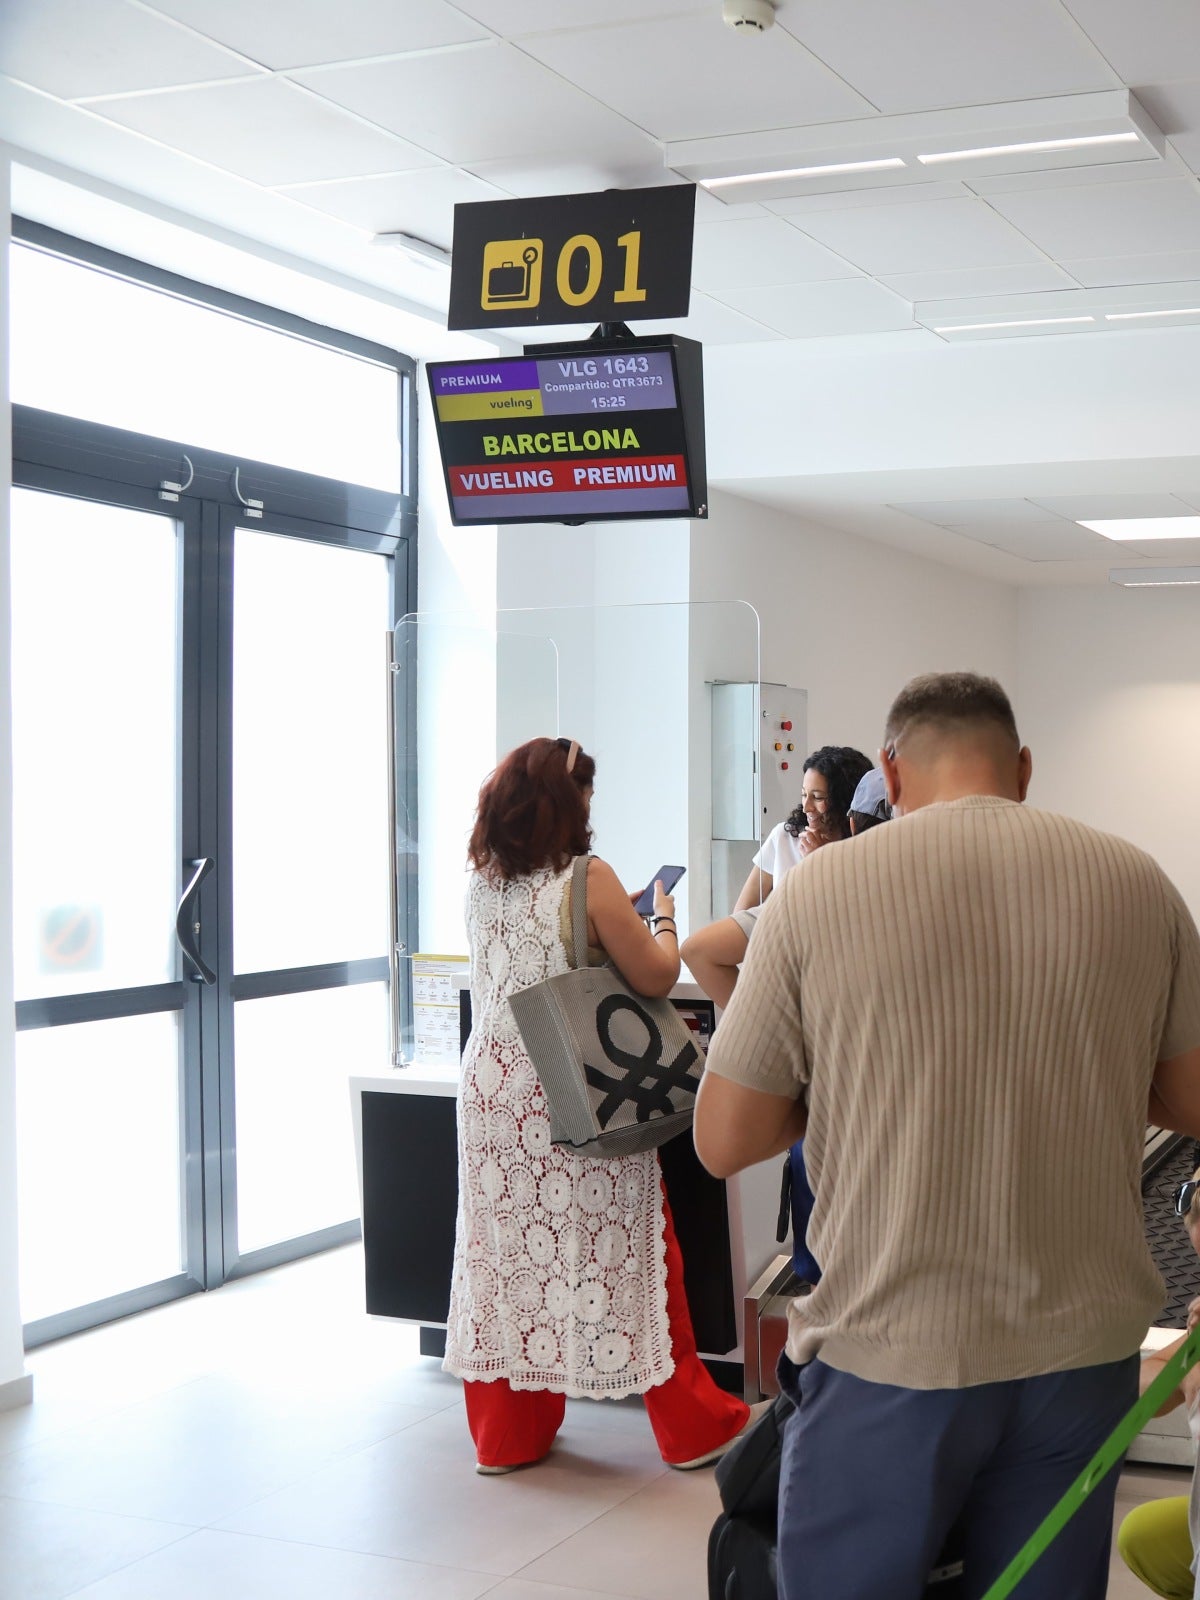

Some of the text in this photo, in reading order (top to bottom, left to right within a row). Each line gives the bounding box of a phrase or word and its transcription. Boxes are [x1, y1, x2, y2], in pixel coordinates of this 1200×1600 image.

[556, 231, 647, 306] 01
[558, 356, 649, 378] VLG 1643
[440, 373, 503, 388] PREMIUM
[544, 376, 663, 393] Compartido: QTR3673
[489, 397, 533, 410] vueling
[591, 396, 626, 409] 15:25
[482, 428, 641, 456] BARCELONA
[459, 463, 677, 491] VUELING PREMIUM
